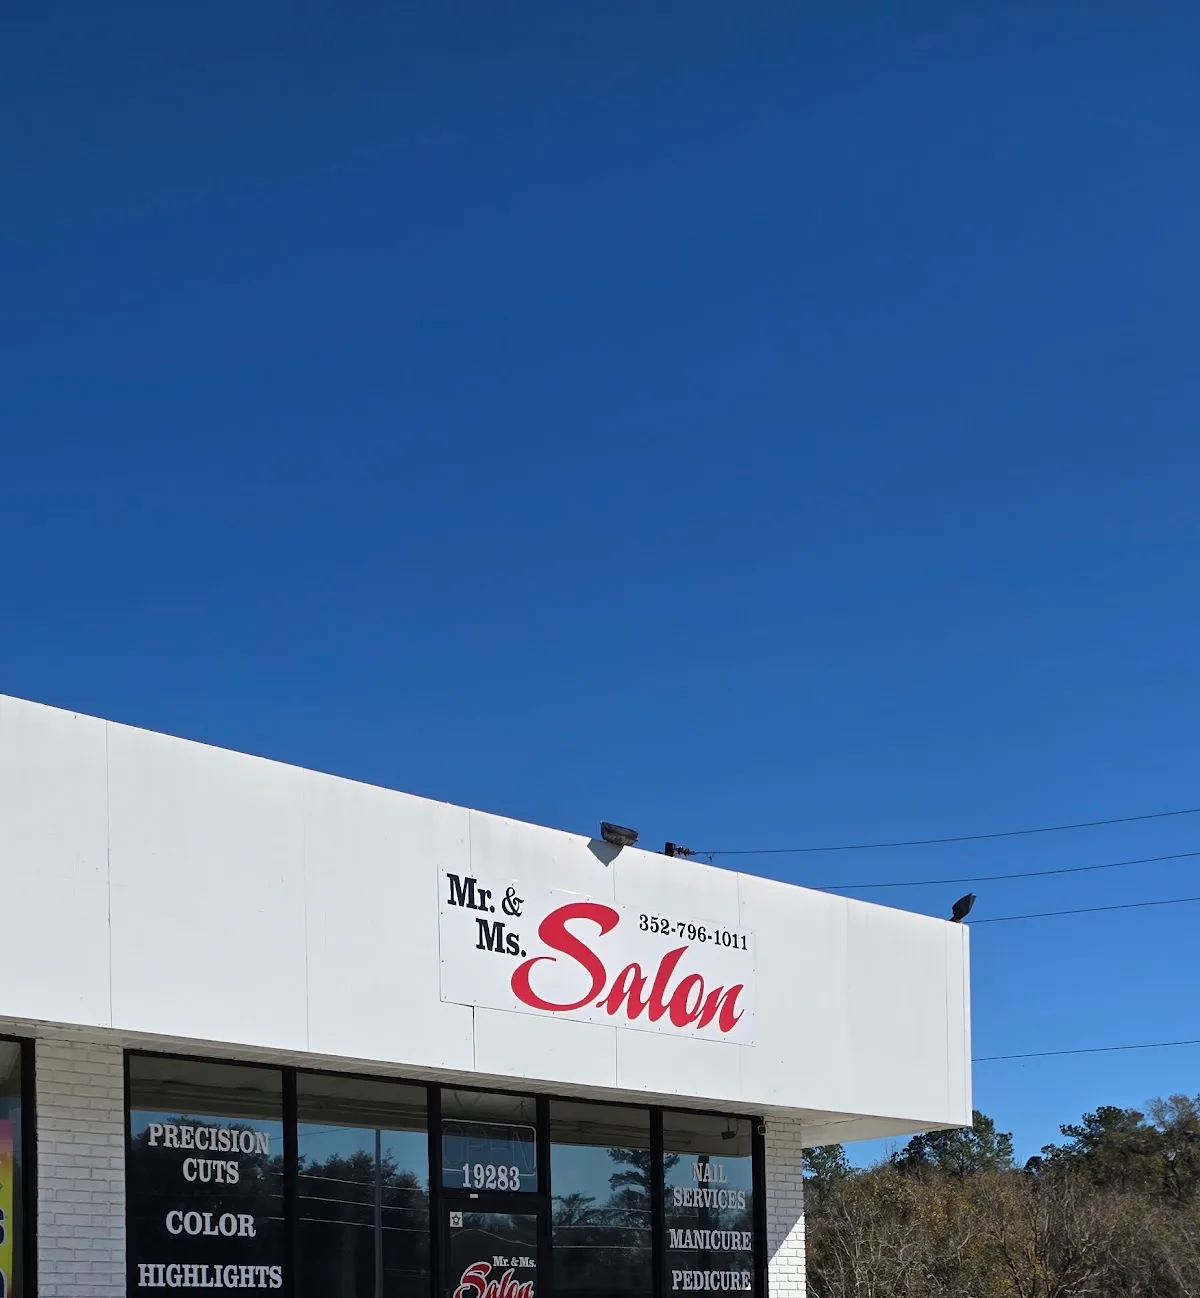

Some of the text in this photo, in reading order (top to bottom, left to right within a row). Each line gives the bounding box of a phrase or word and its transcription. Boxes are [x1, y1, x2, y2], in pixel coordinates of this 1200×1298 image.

[446, 873, 525, 917] Mr. &
[476, 918, 527, 958] Ms.
[639, 914, 748, 951] 352-796-1011
[511, 902, 745, 1033] Salon
[148, 1123, 270, 1155] PRECISION
[182, 1158, 240, 1185] CUTS
[462, 1163, 520, 1191] 19283
[691, 1162, 728, 1184] NAIL
[673, 1187, 746, 1210] SERVICES
[165, 1210, 257, 1237] COLOR
[669, 1228, 752, 1251] MANICURE
[492, 1255, 537, 1267] Mr. & Ms.
[138, 1263, 283, 1289] HIGHLIGHTS
[672, 1270, 751, 1291] PEDICURE
